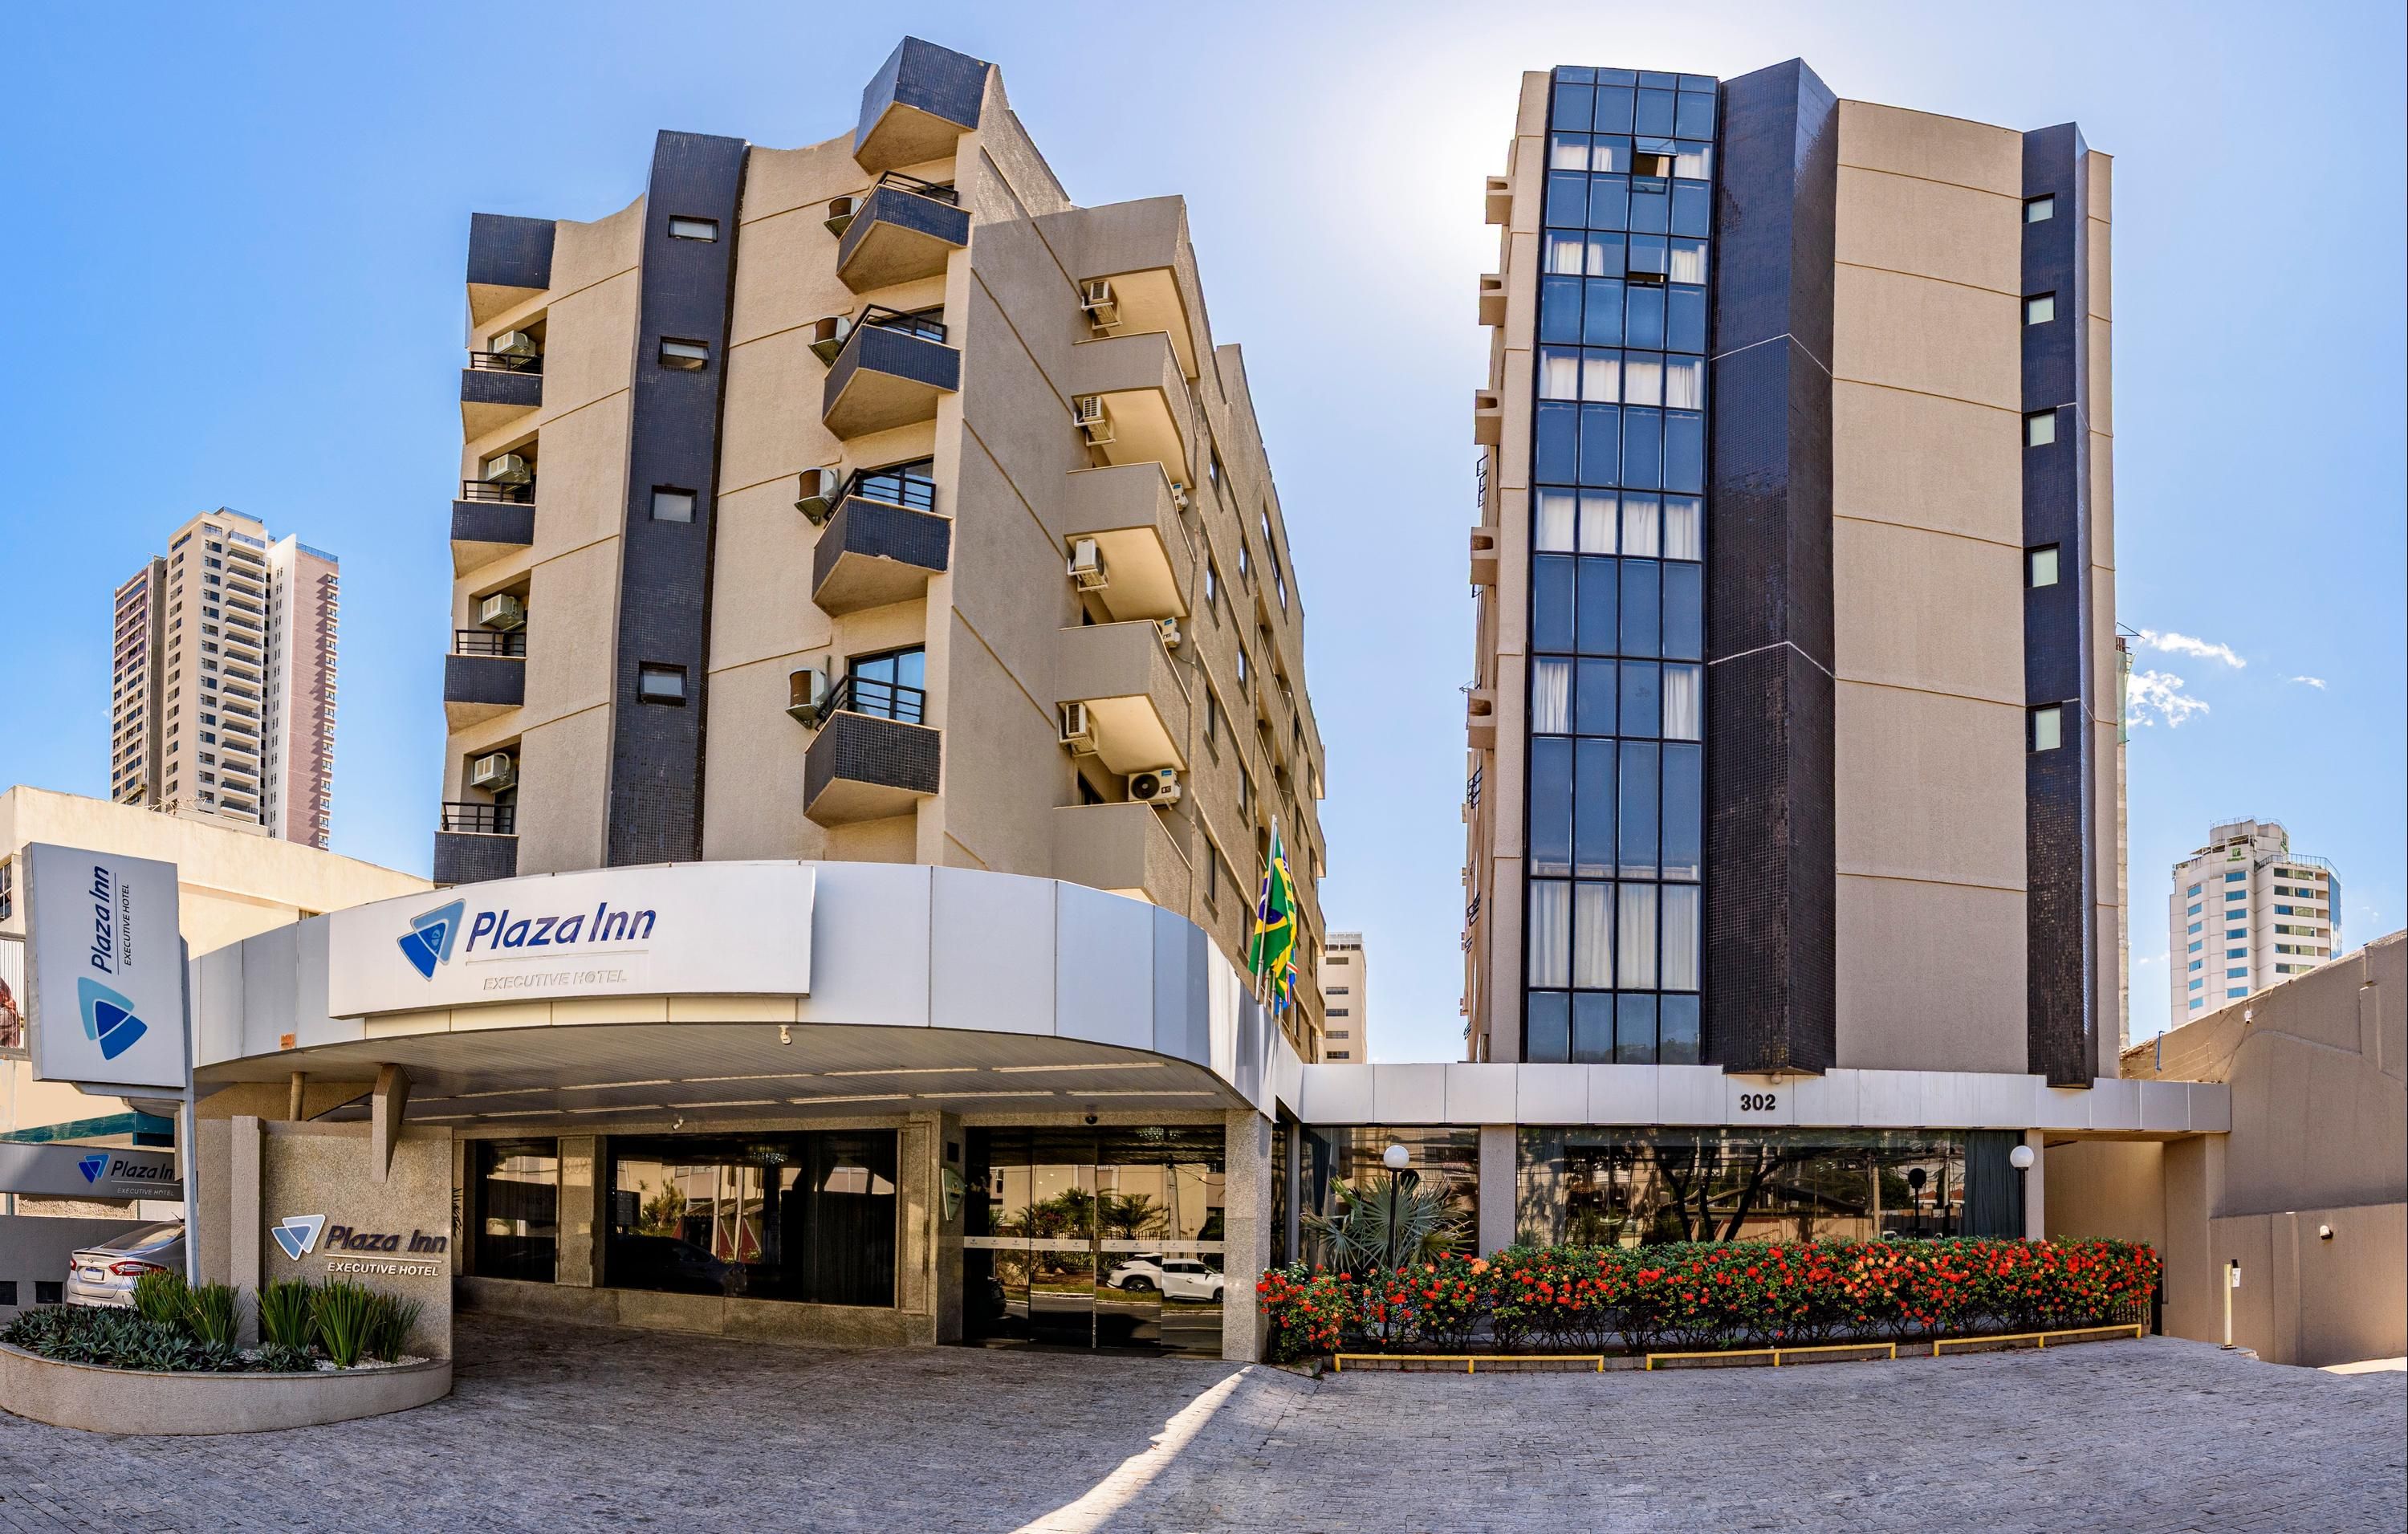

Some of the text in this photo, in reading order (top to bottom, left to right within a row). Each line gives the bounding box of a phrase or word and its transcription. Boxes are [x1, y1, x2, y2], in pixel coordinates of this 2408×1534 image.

[89, 865, 112, 974] Plaza Inn
[122, 884, 131, 966] EXECUTIVE HOTEL
[466, 902, 657, 952] Plaza Inn
[483, 970, 628, 991] EXECUTIVE HOTEL
[1740, 1093, 1775, 1111] 302
[111, 1160, 176, 1180] Plaza In
[117, 1187, 174, 1197] EXECUTIVE HOTEL
[324, 1225, 447, 1253] Plaza Inn
[327, 1262, 439, 1276] EXECUTIVE HOTEL
